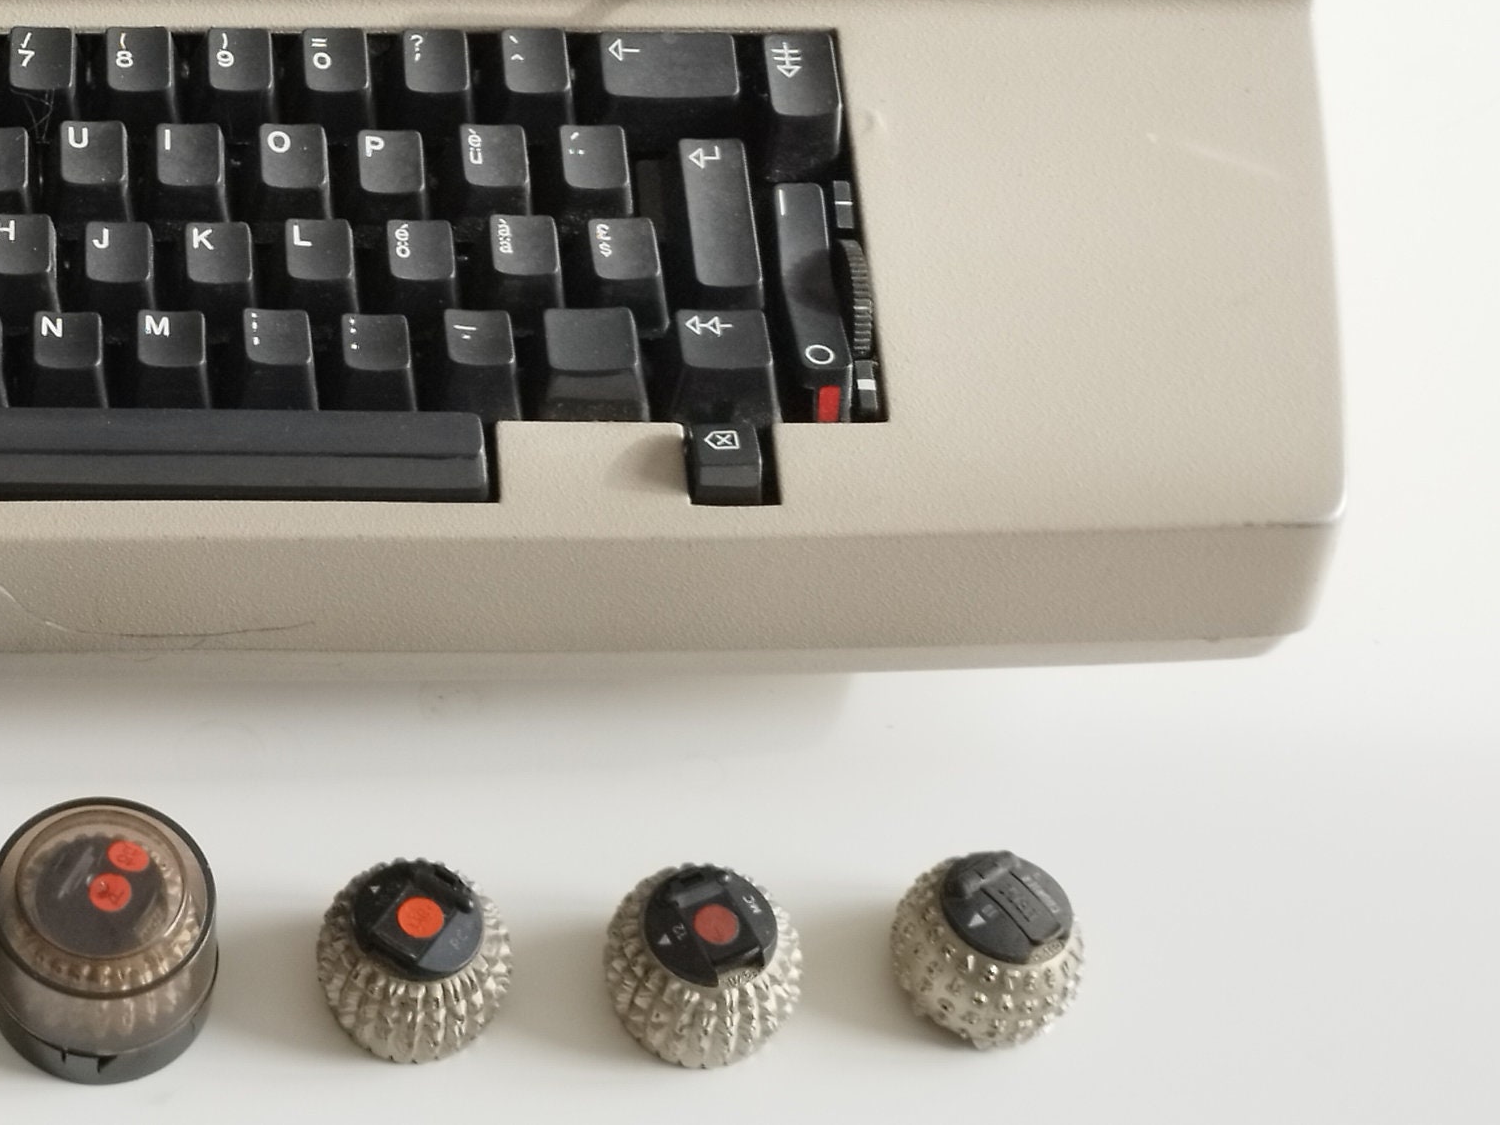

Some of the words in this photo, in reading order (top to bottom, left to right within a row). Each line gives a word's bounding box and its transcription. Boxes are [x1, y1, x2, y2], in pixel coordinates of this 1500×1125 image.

[410, 34, 424, 51] ?
[17, 49, 35, 67] 7
[115, 50, 134, 68] 8
[215, 50, 235, 68] 9
[312, 51, 332, 70] 0
[67, 127, 89, 148] U
[163, 128, 171, 151] I
[267, 130, 291, 153] O
[365, 136, 385, 158] P
[468, 145, 483, 165] ü
[92, 227, 110, 249] J
[192, 228, 214, 250] K
[292, 225, 312, 248] L
[396, 240, 411, 259] ö
[40, 316, 63, 338] N
[145, 315, 170, 337] M
